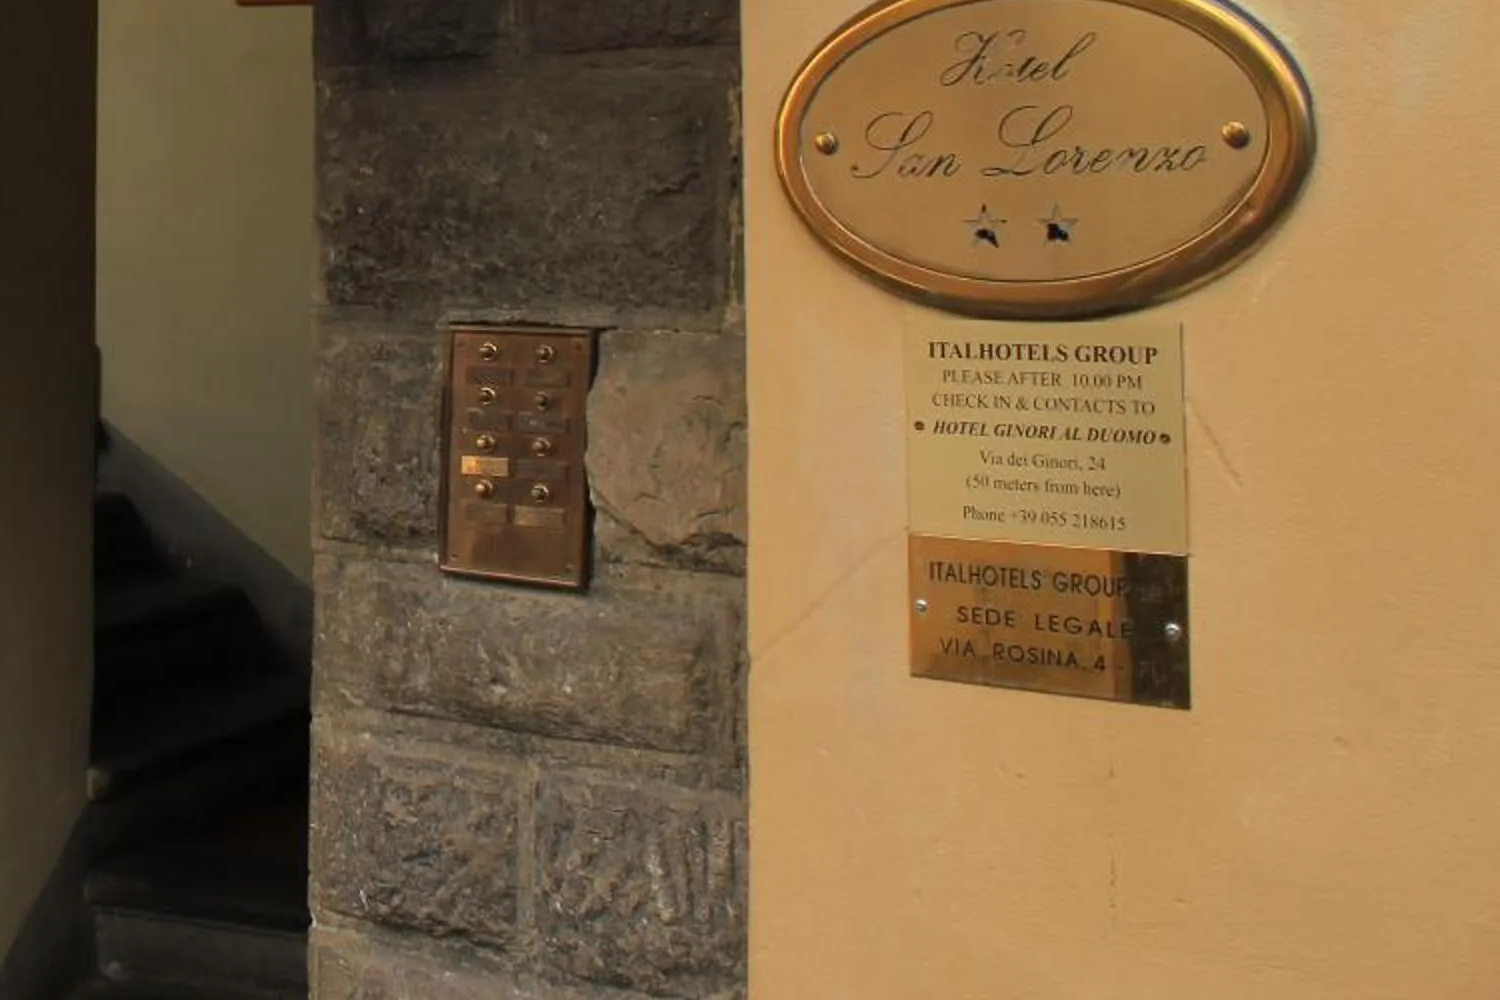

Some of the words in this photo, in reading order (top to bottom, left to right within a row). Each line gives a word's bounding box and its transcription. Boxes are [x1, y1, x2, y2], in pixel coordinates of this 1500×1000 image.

[851, 110, 963, 179] San
[982, 105, 1208, 177] Lorenzo
[928, 341, 1069, 362] ITALHOTELS
[1074, 344, 1158, 365] GROUP
[942, 369, 1005, 385] PLEASE
[1008, 371, 1062, 387] AFTER
[1116, 374, 1143, 391] PM
[931, 392, 989, 409] CHECK
[993, 395, 1012, 409] IN
[1015, 396, 1029, 411] &
[1033, 397, 1127, 415] CONTACTS
[1131, 400, 1156, 416] TO
[933, 420, 989, 437] HOTEL
[993, 423, 1057, 440] GINORI
[1059, 426, 1082, 441] AL
[1087, 427, 1157, 445] DUOMO
[980, 450, 1003, 466] Via
[1007, 451, 1028, 468] dei
[1088, 455, 1106, 471] 24
[965, 474, 989, 490] (50
[993, 477, 1039, 493] meters
[1045, 480, 1079, 495] from
[1083, 480, 1121, 499] here)
[963, 505, 1005, 523] Phone
[1010, 508, 1037, 524] +39
[1040, 511, 1068, 528] 055
[928, 560, 1042, 591] ITALHOTELS
[1052, 571, 1128, 598] GROUP
[956, 605, 1017, 628] SEDE
[1034, 612, 1133, 640] LEGALE
[940, 637, 977, 658] VIA
[1093, 654, 1106, 672] 4
